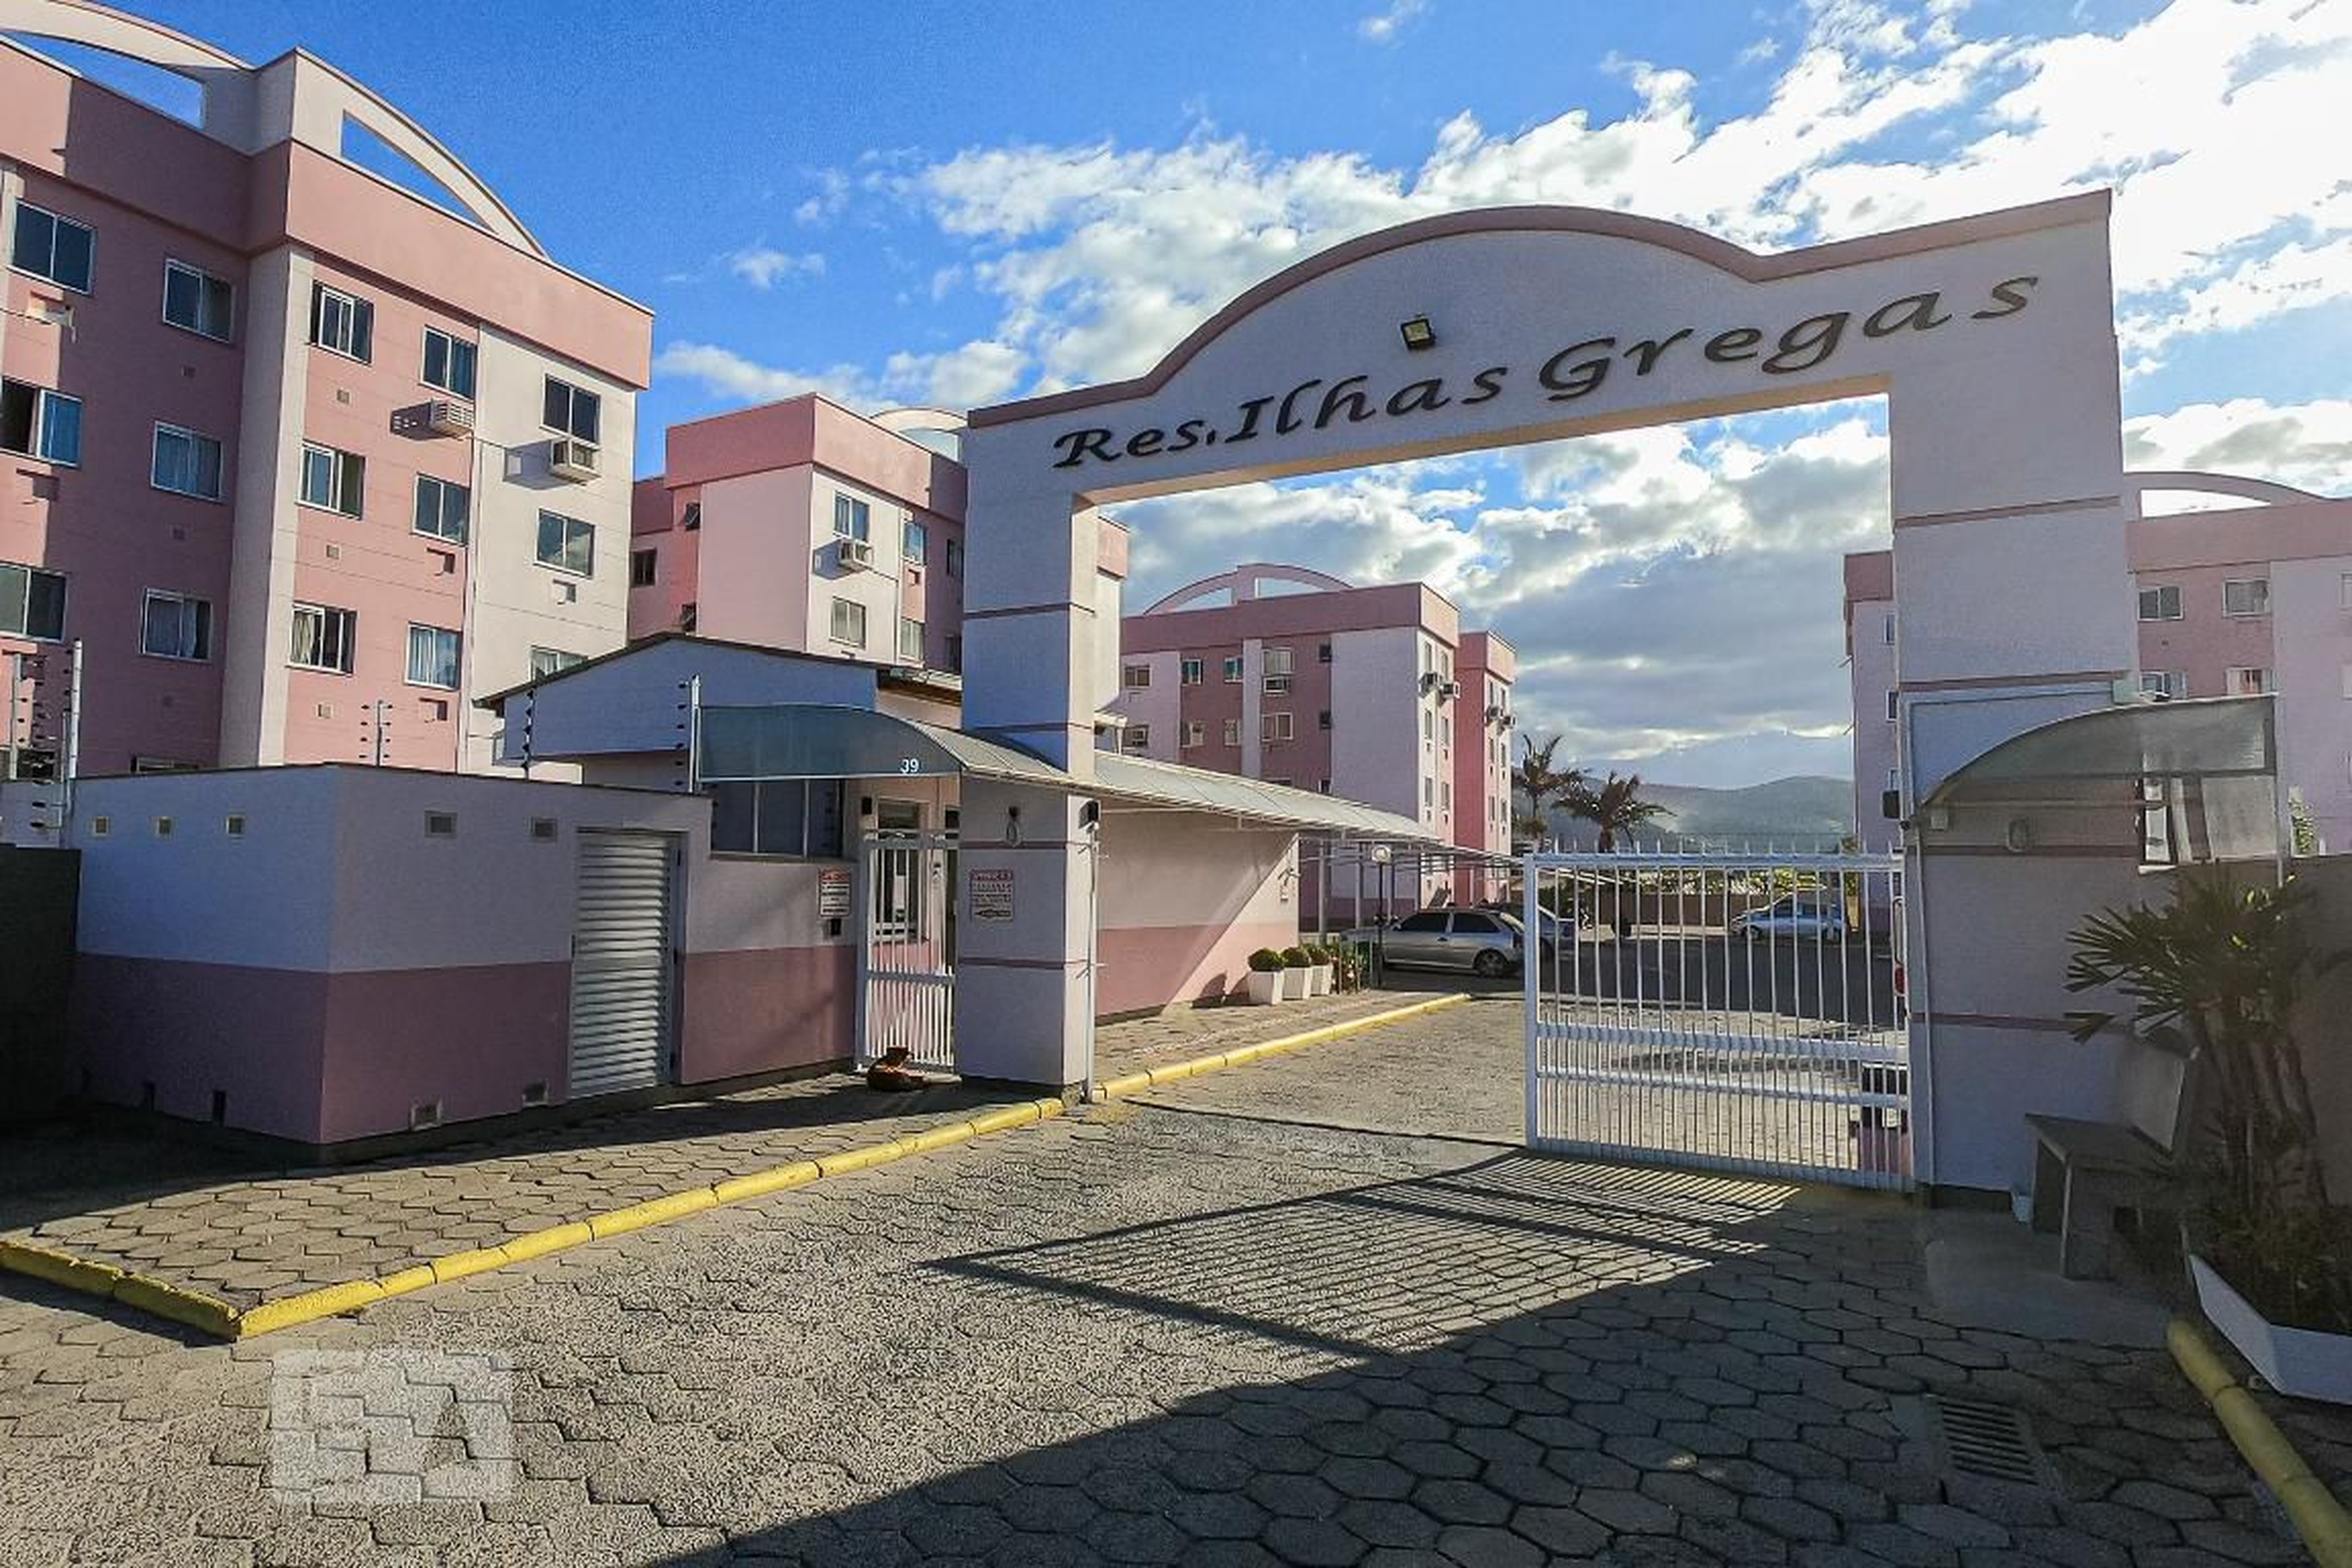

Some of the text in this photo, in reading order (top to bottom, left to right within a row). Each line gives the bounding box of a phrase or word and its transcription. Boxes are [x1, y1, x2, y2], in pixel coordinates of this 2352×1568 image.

[1052, 277, 2039, 469] Res. Ilhas Gregas
[900, 758, 919, 773] 39
